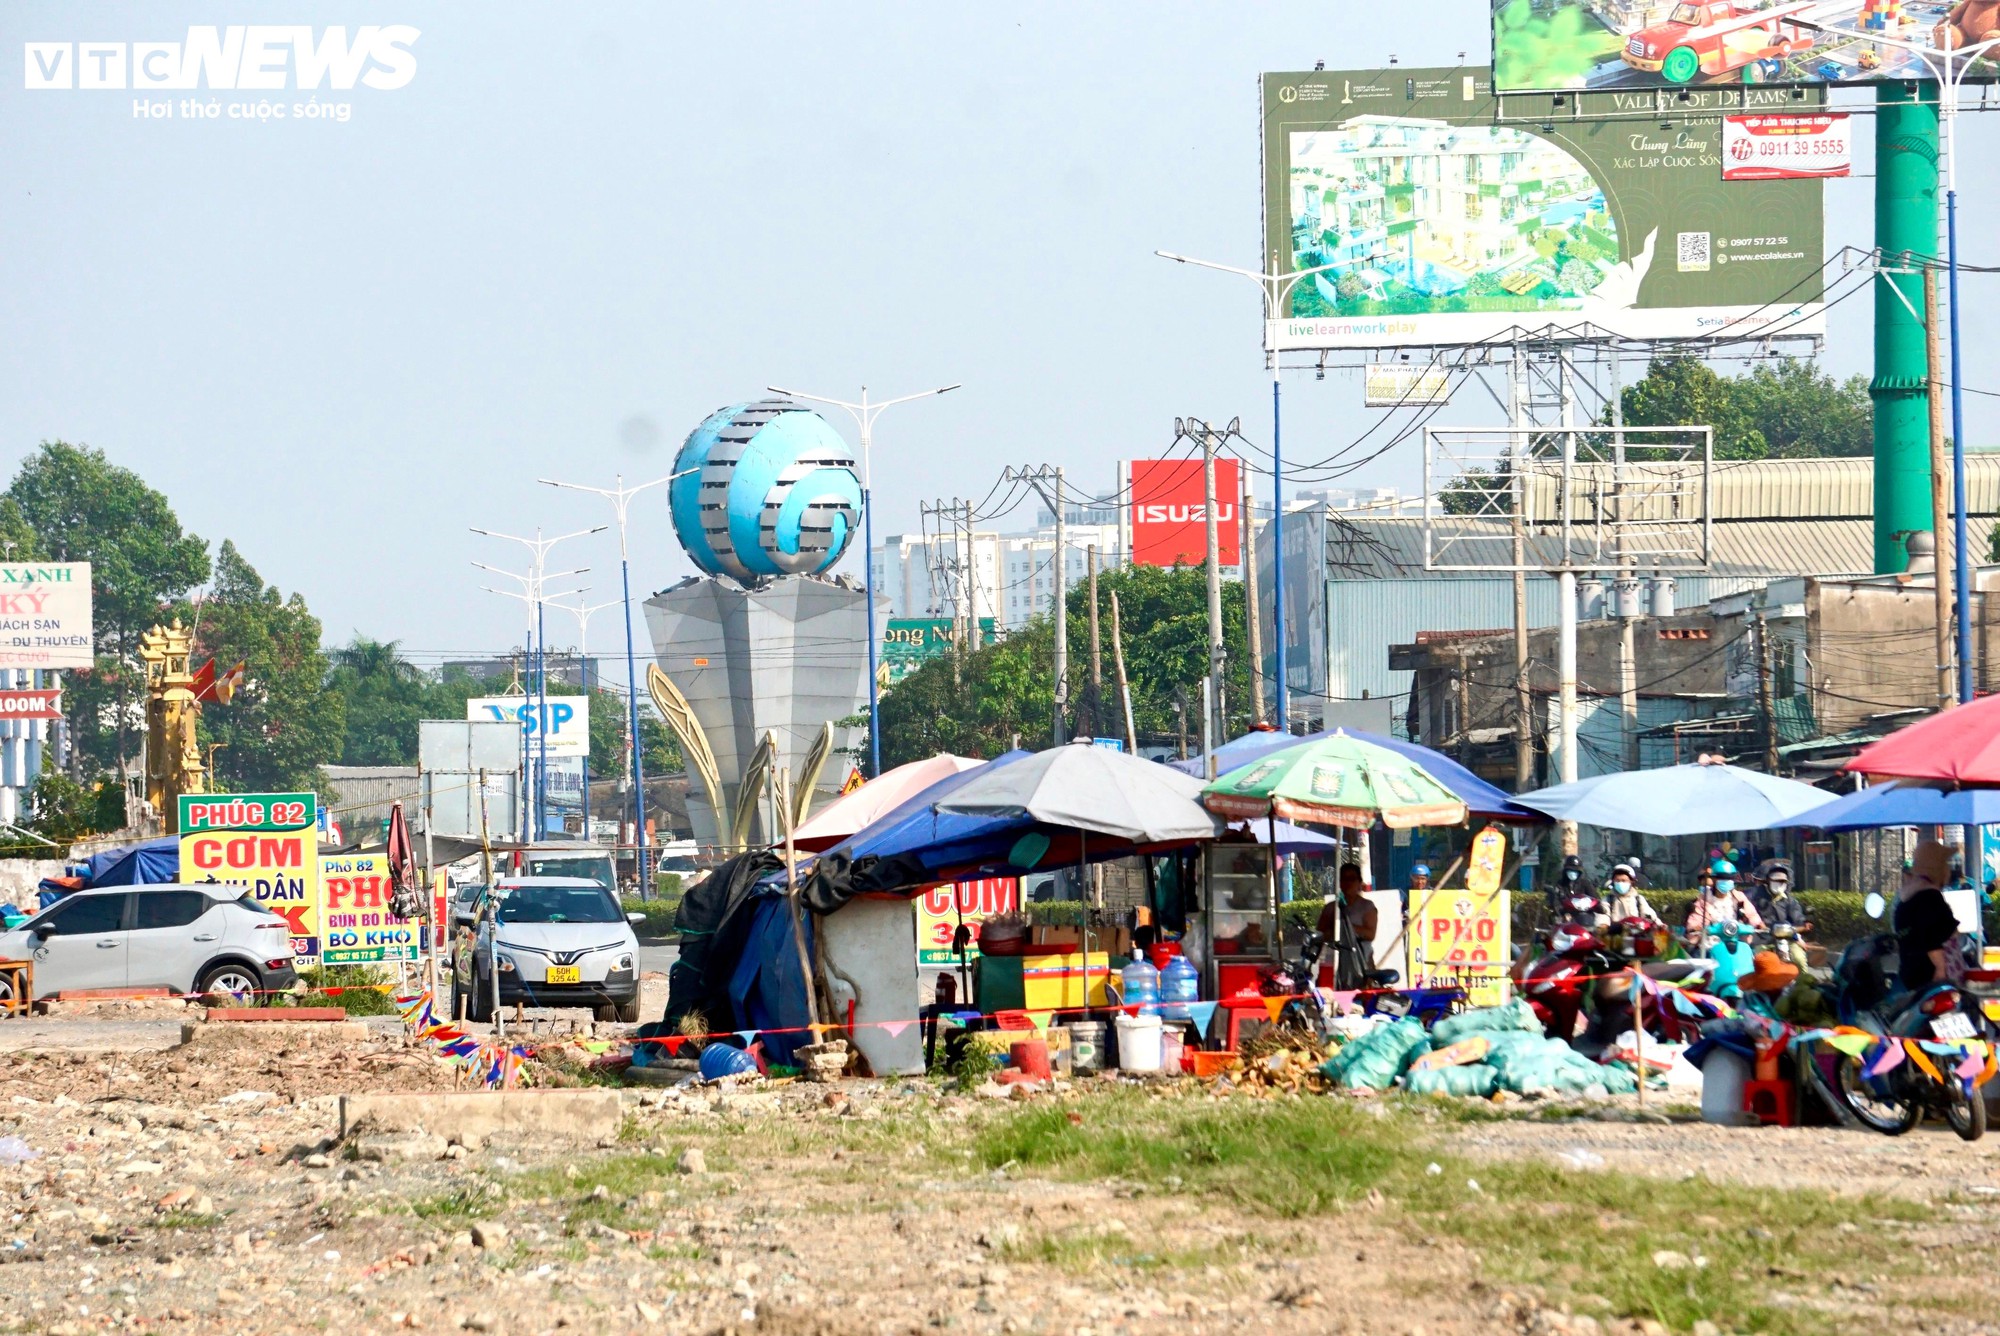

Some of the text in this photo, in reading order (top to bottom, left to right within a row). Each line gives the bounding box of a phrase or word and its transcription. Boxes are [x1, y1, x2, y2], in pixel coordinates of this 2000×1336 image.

[1612, 89, 1789, 110] VALLEY OF DREAMS
[1683, 112, 1722, 127] LUXU
[1628, 133, 1669, 154] Thung
[1672, 132, 1708, 153] Lũng
[1760, 139, 1844, 156] 0911 39 5555
[1612, 153, 1722, 170] XÁC LẬP CUỘC SỐN
[1730, 236, 1788, 247] 0907 57 22 55
[1730, 251, 1804, 262] www.ecolakes.vn
[1288, 320, 1417, 336] livelearnworkplay
[1137, 503, 1233, 524] ISUZU
[2, 567, 73, 583] XANH
[0, 586, 50, 615] KÝ
[34, 619, 61, 632] SẠN
[883, 628, 925, 647] ong
[189, 798, 306, 827] PHÚC 82
[193, 835, 303, 869] CƠM
[325, 860, 374, 873] Phở 82
[256, 872, 304, 900] DÂN
[1430, 910, 1498, 943] PHỞ
[329, 928, 411, 947] BÒ KHO
[296, 956, 316, 966] ời!
[551, 974, 577, 983] 325 44
[556, 966, 571, 975] 60H
